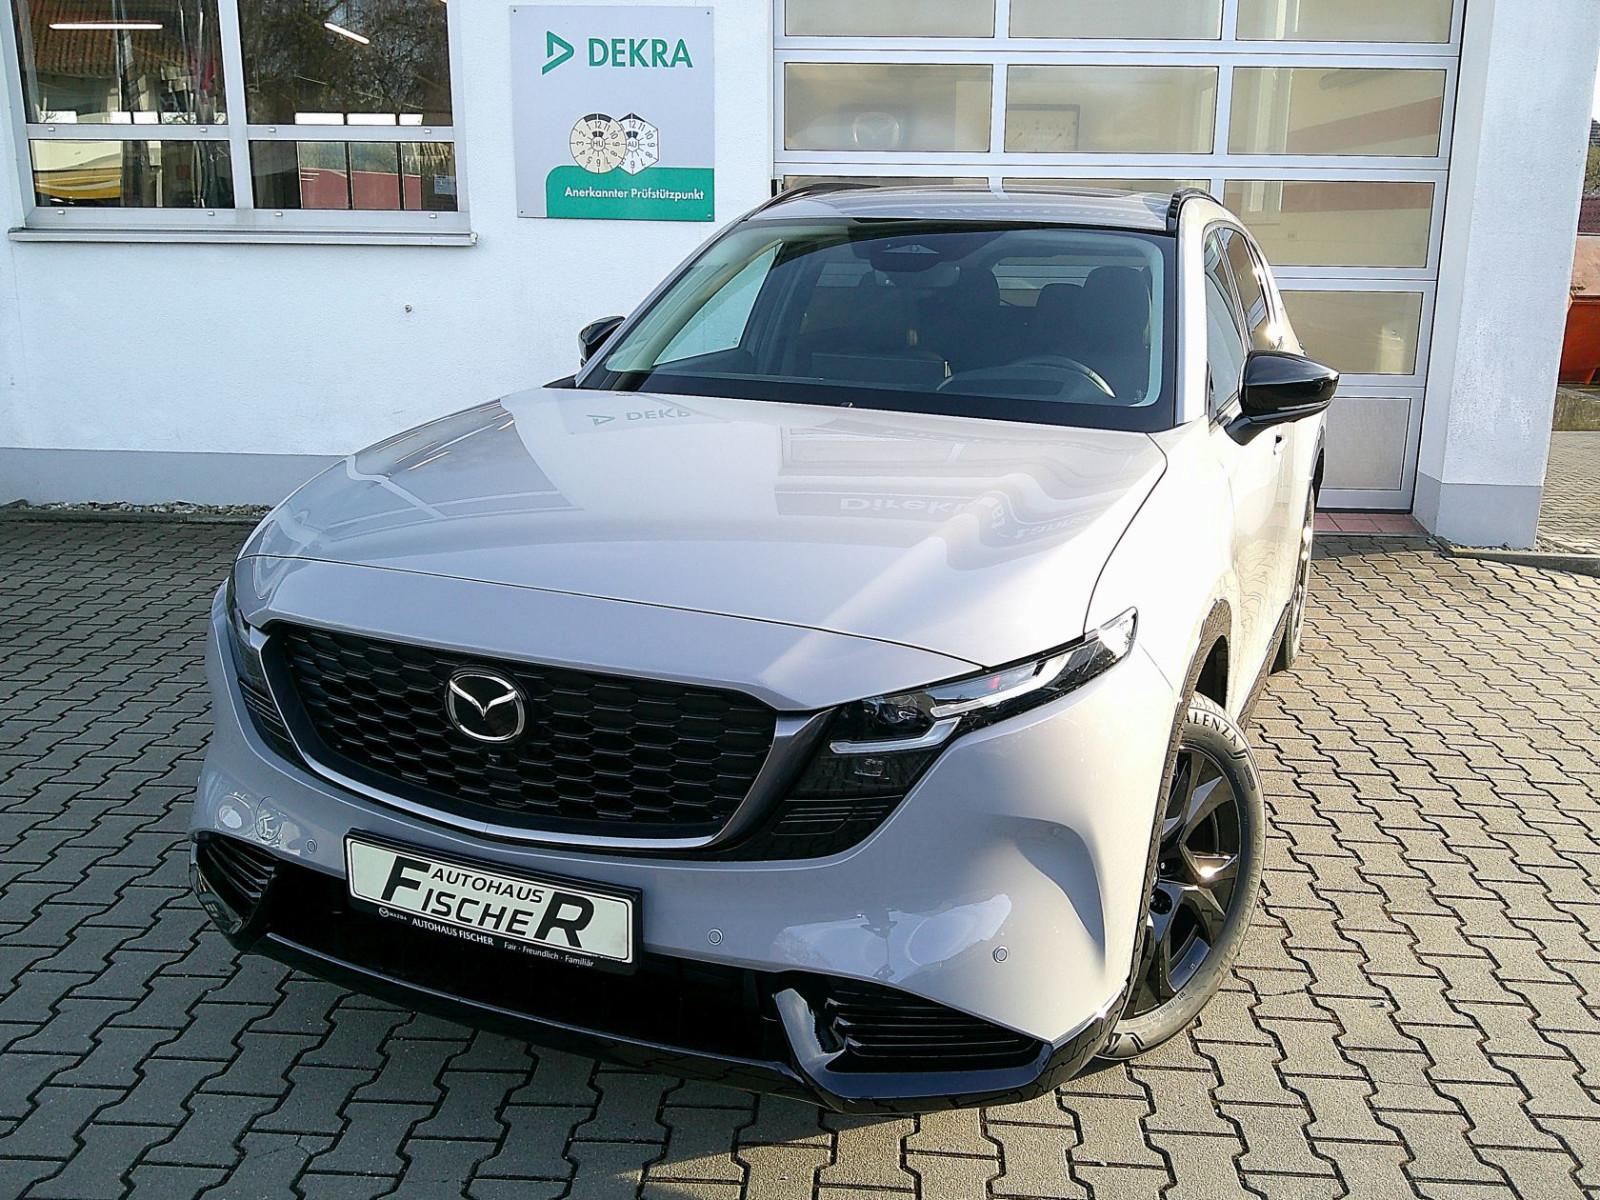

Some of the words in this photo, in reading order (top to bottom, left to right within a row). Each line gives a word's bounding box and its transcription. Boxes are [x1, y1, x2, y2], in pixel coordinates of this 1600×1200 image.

[588, 38, 693, 68] DEKRA
[594, 121, 602, 129] 12
[629, 120, 636, 129] 12
[564, 186, 627, 199] Anerkannter
[630, 188, 704, 202] Prüfstützpunkt
[430, 868, 545, 904] AUTOHAUS
[412, 917, 458, 937] AUTOHAUS
[459, 929, 494, 946] FISCHER
[504, 941, 518, 951] Fair
[522, 945, 559, 961] Freundlich
[564, 954, 594, 968] Familiär
